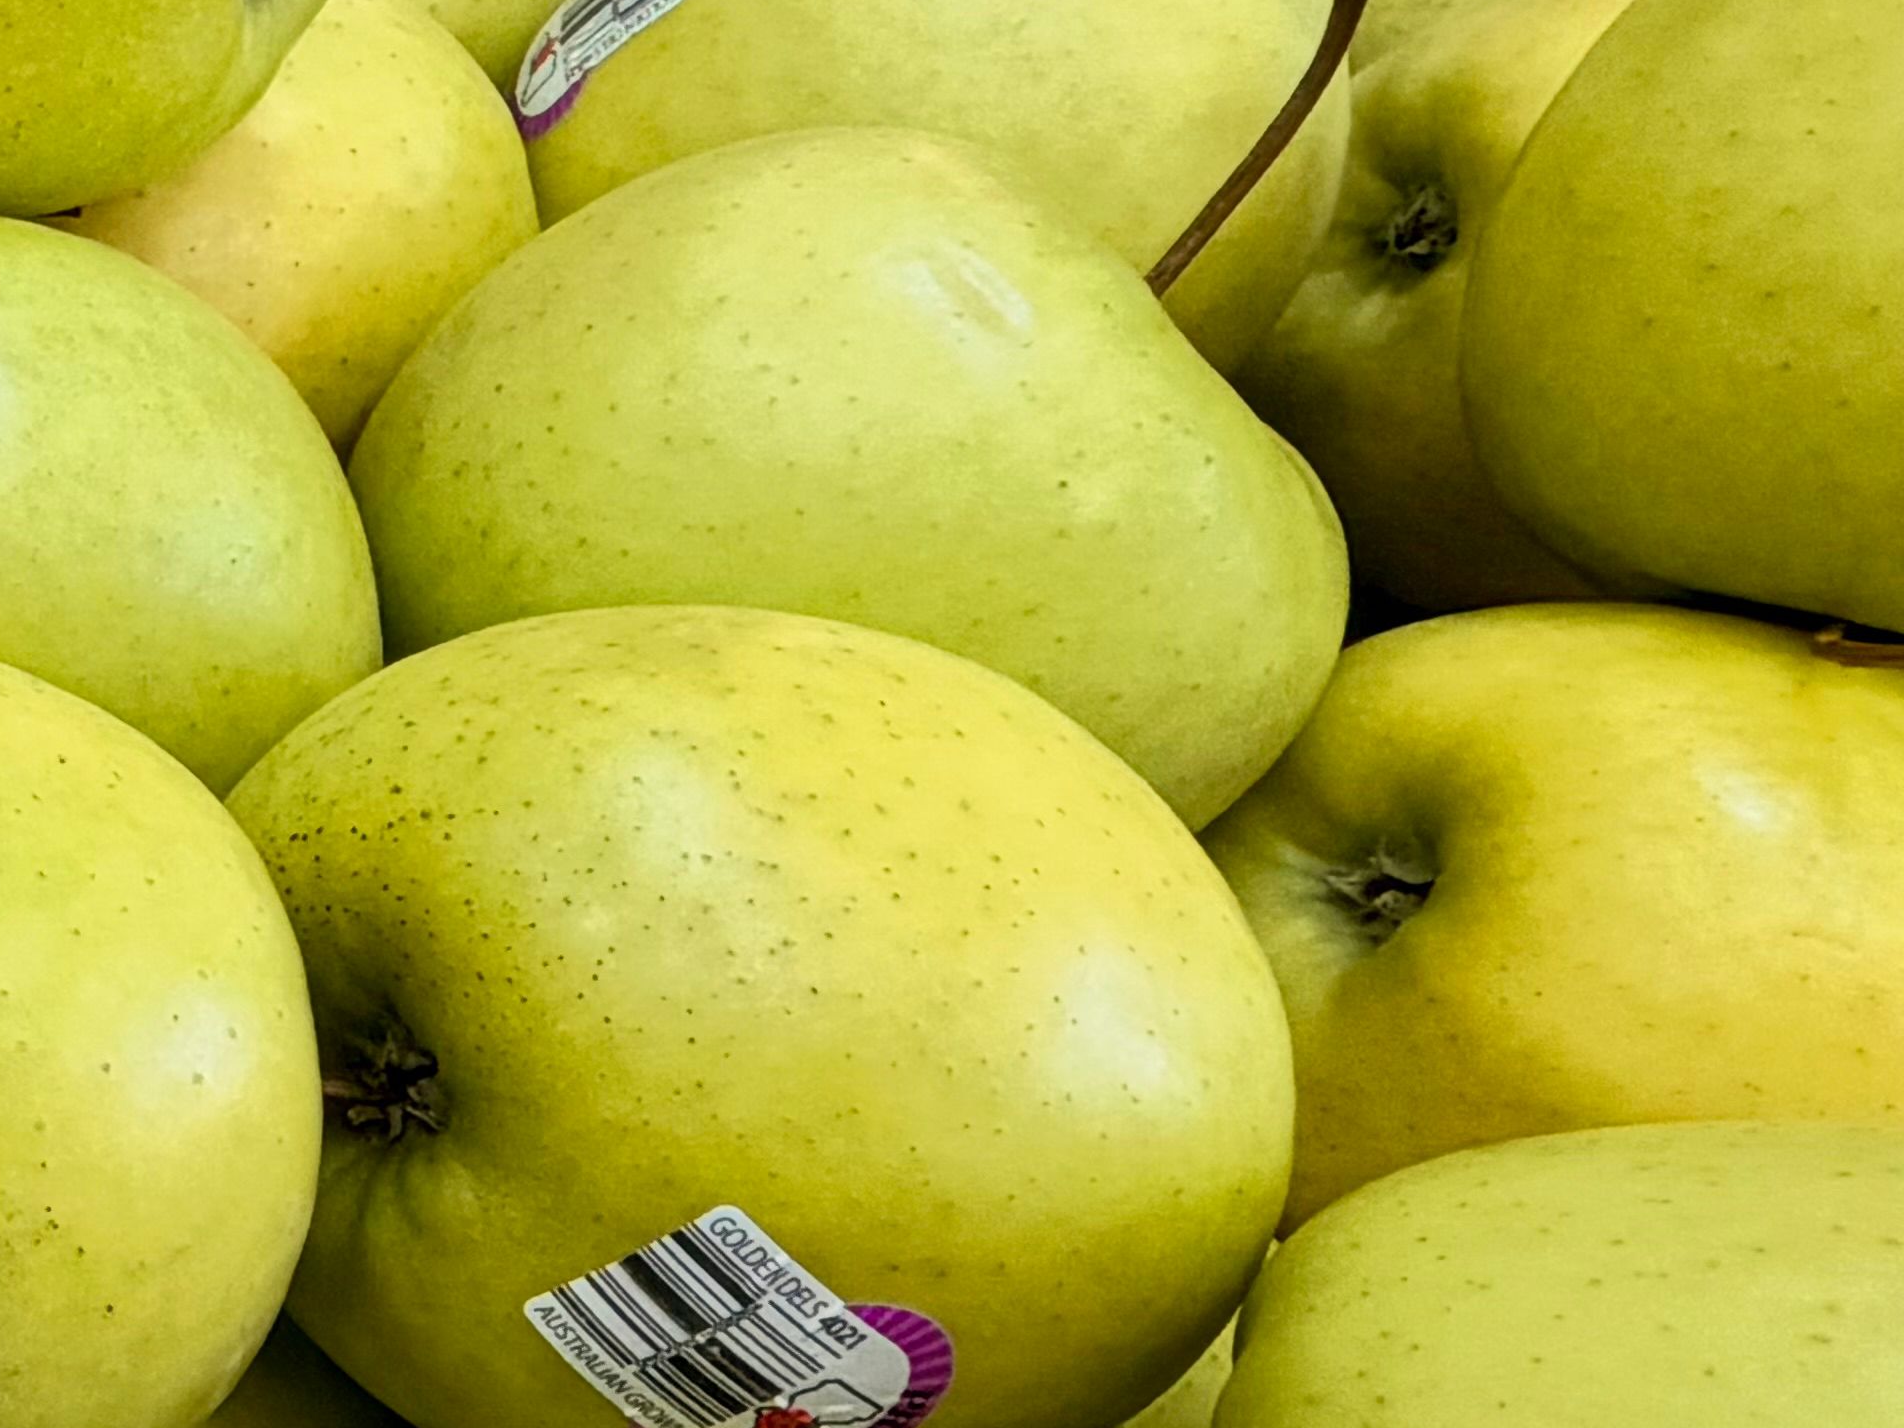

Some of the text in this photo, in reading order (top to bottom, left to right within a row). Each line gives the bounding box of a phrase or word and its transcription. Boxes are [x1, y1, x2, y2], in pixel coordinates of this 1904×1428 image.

[710, 1216, 869, 1351] GOLDEN DELS 4021
[534, 1305, 629, 1395] AUSTRALIAN
